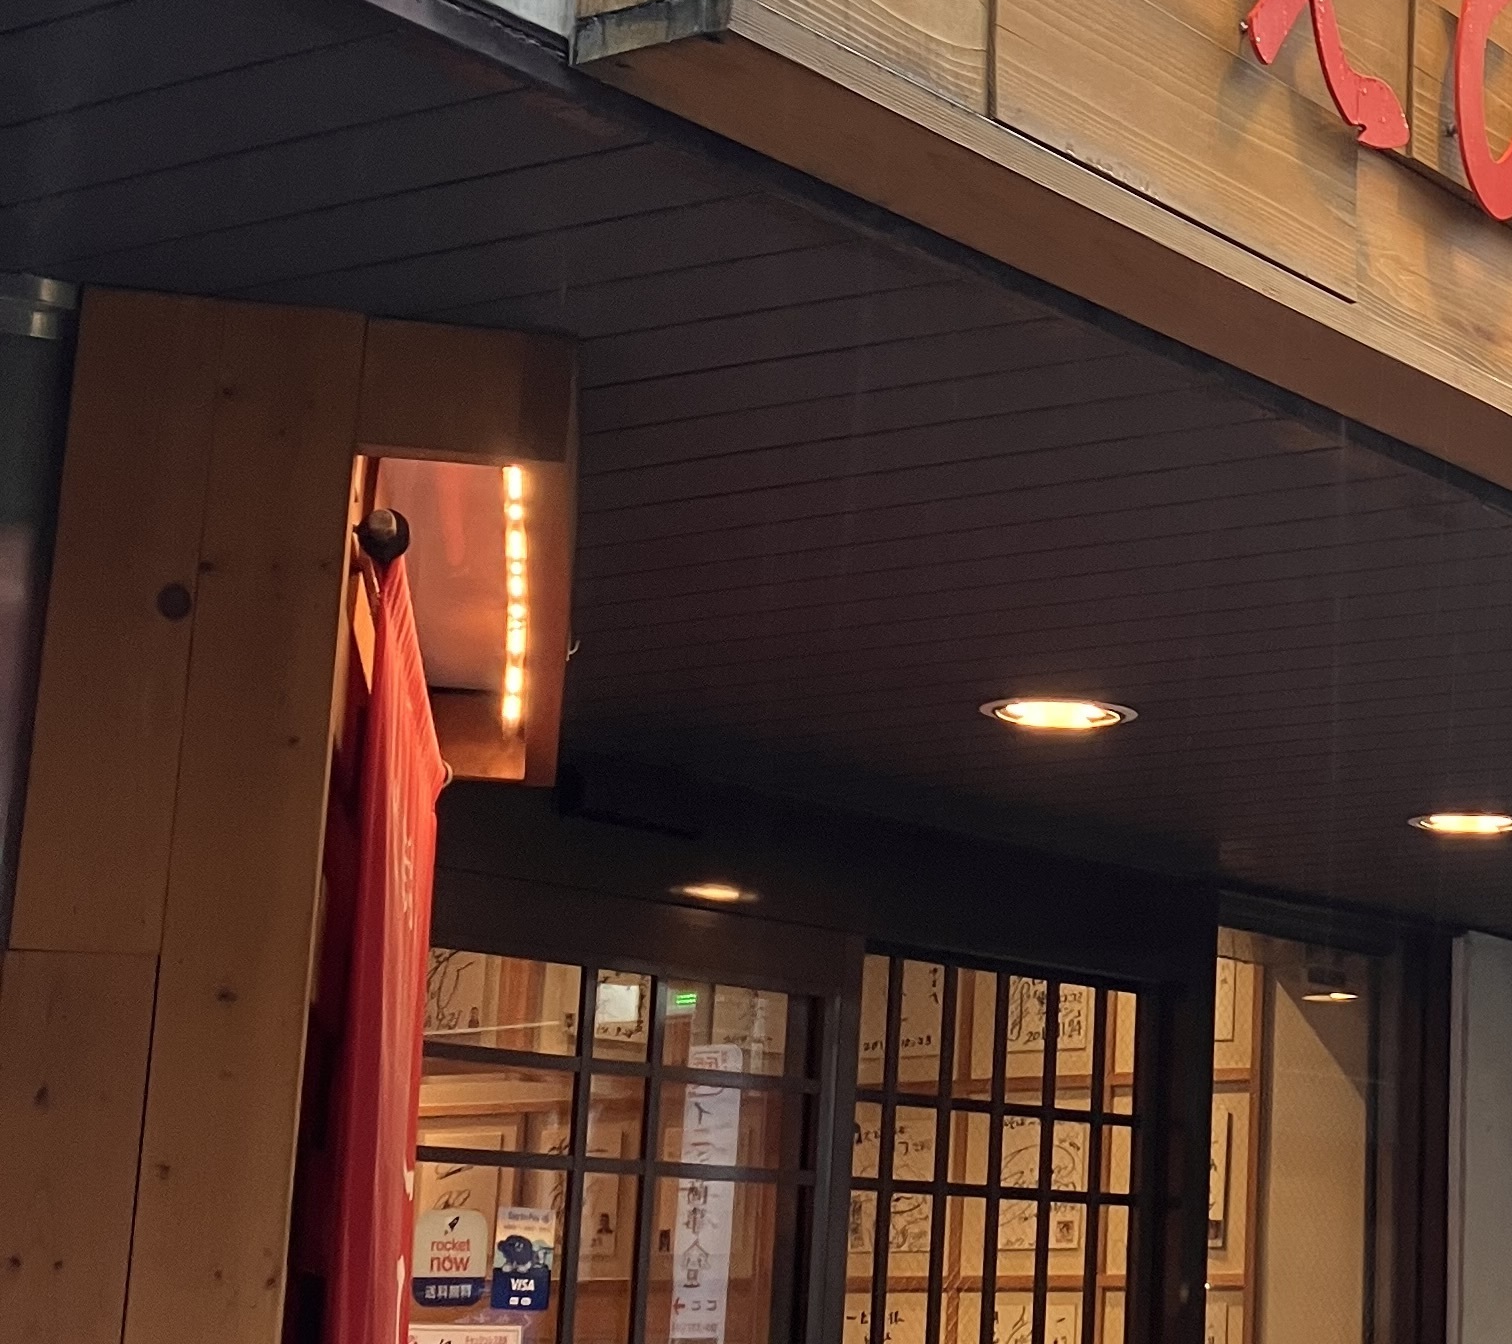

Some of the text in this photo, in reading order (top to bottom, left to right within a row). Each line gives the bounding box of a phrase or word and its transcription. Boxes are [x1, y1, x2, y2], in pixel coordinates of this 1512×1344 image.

[430, 1239, 470, 1252] rocket
[430, 1256, 470, 1272] now
[510, 1278, 535, 1291] VISA
